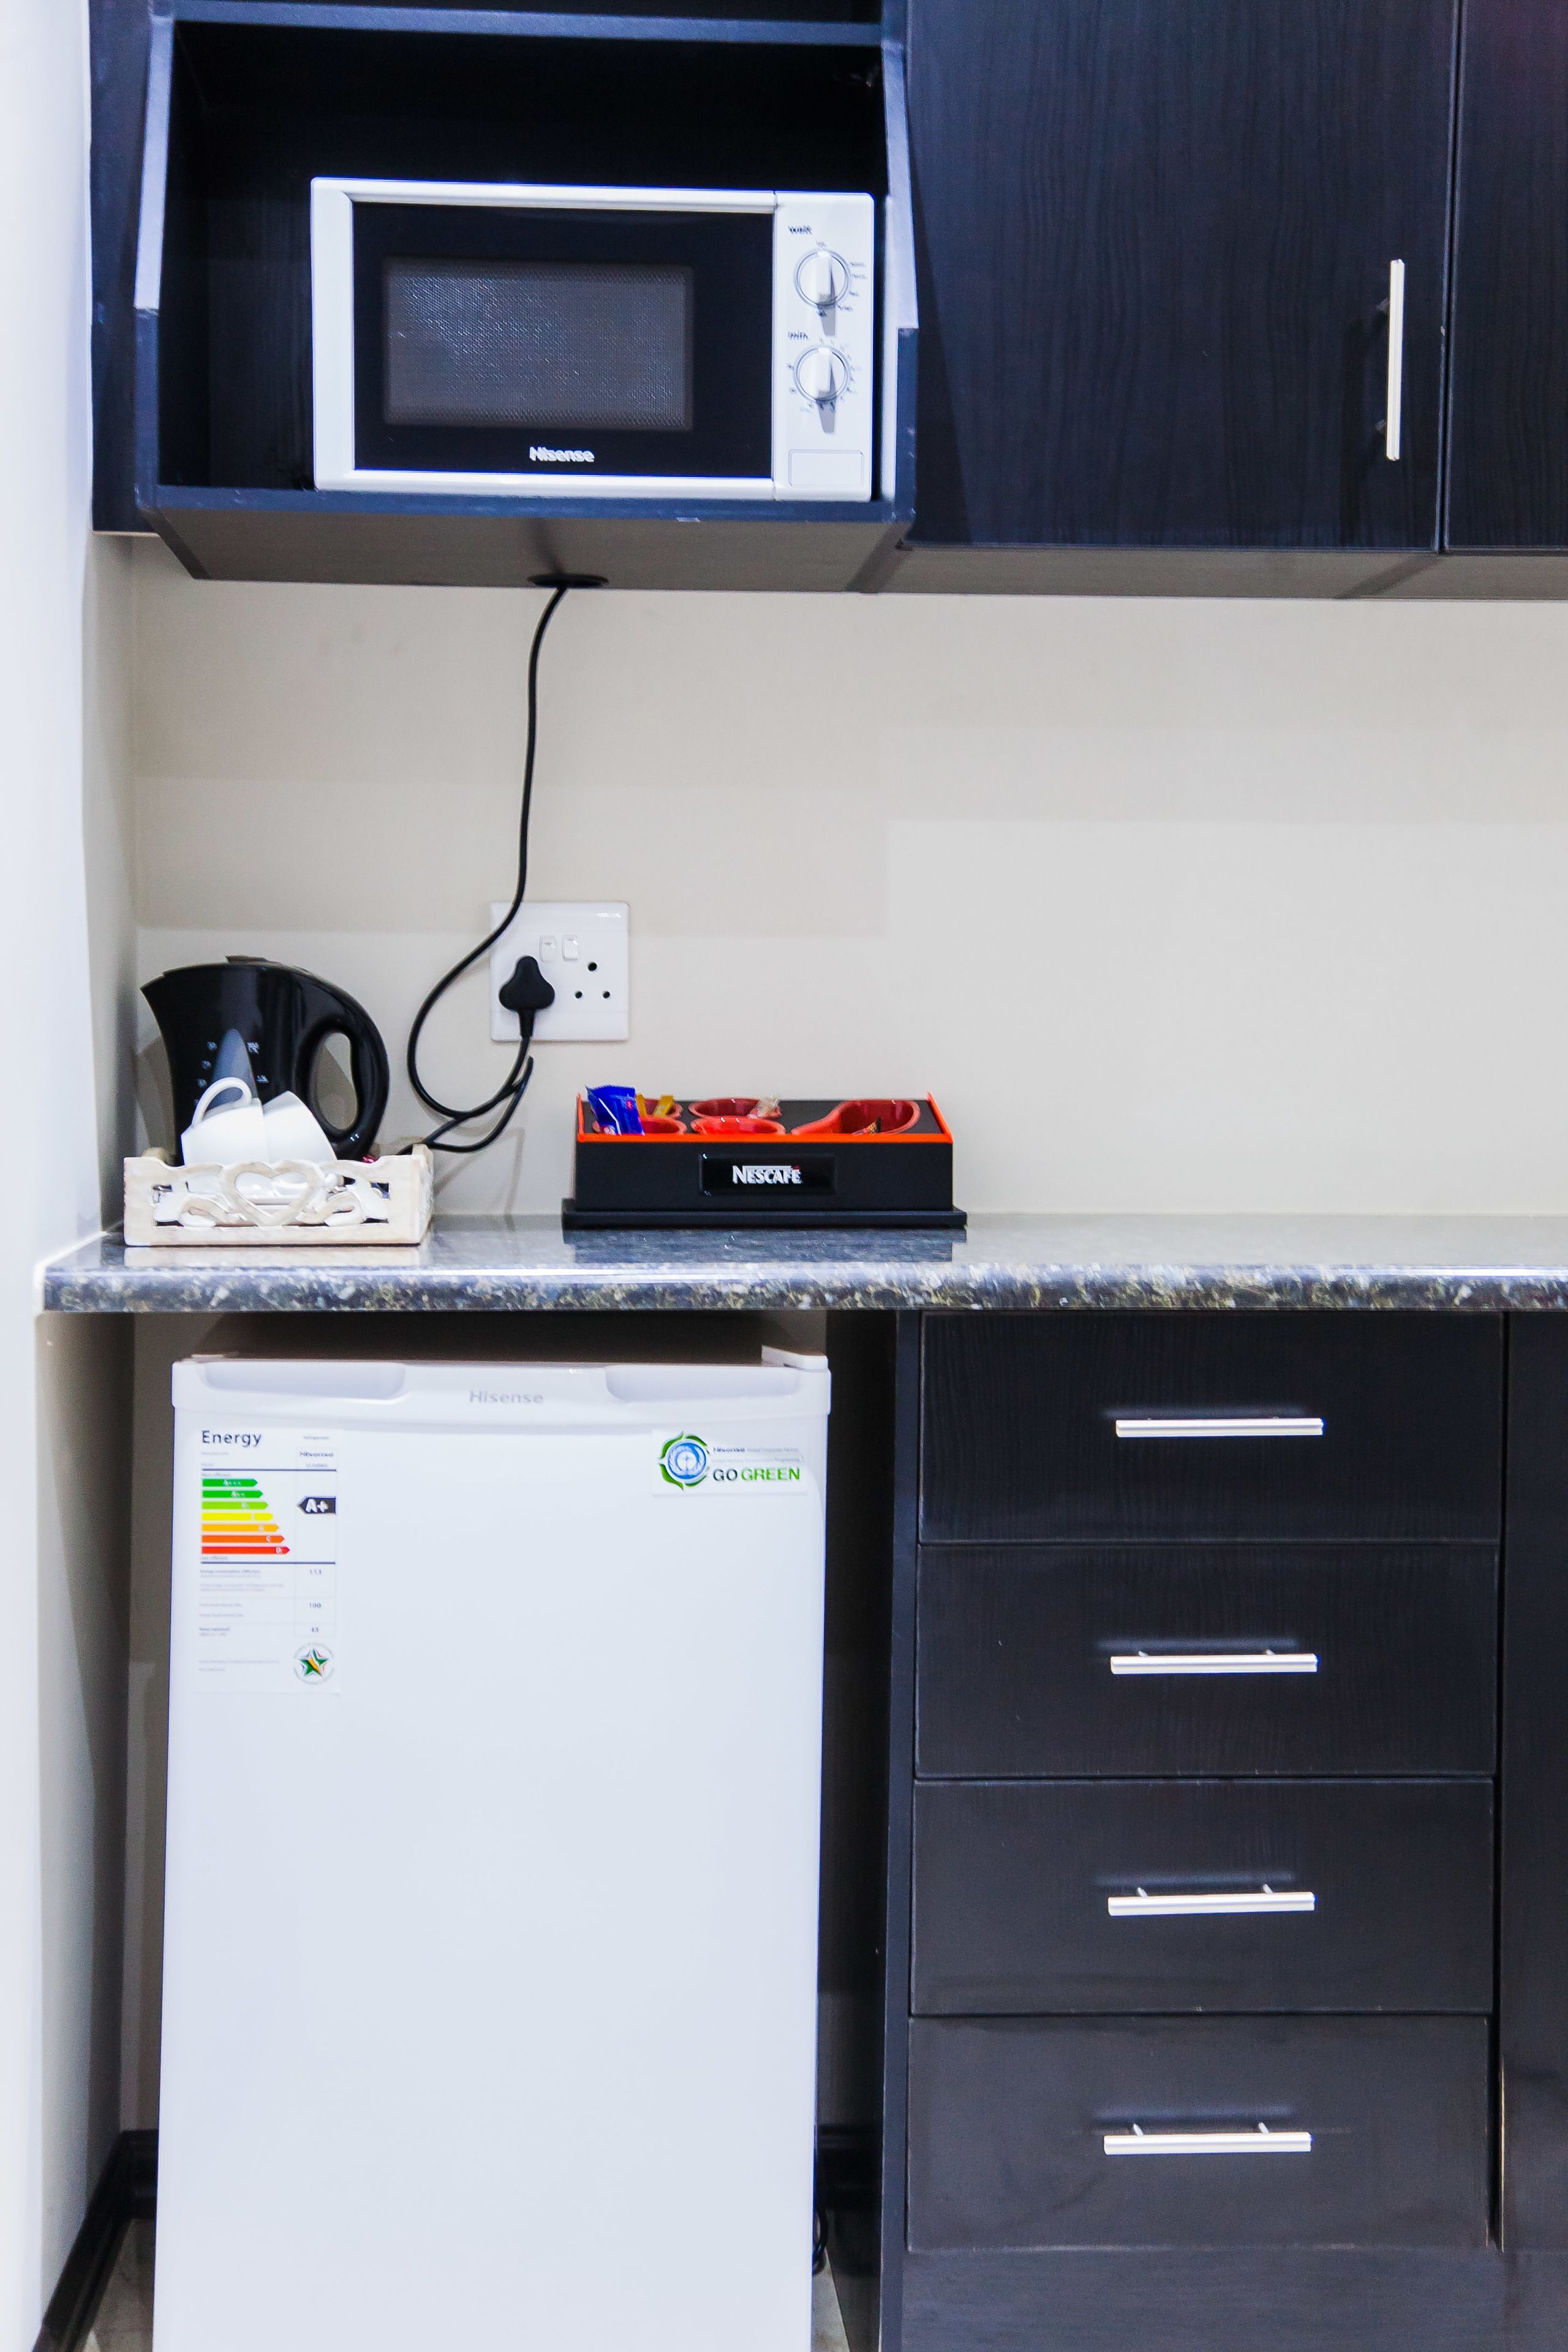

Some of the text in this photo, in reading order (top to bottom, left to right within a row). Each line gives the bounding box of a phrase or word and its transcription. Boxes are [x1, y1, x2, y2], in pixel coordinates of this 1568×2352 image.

[529, 446, 595, 462] Hisense
[469, 1390, 544, 1404] Hisense
[201, 1430, 262, 1447] Energy
[713, 1468, 801, 1481] GO GREEN
[305, 1498, 329, 1513] A+
